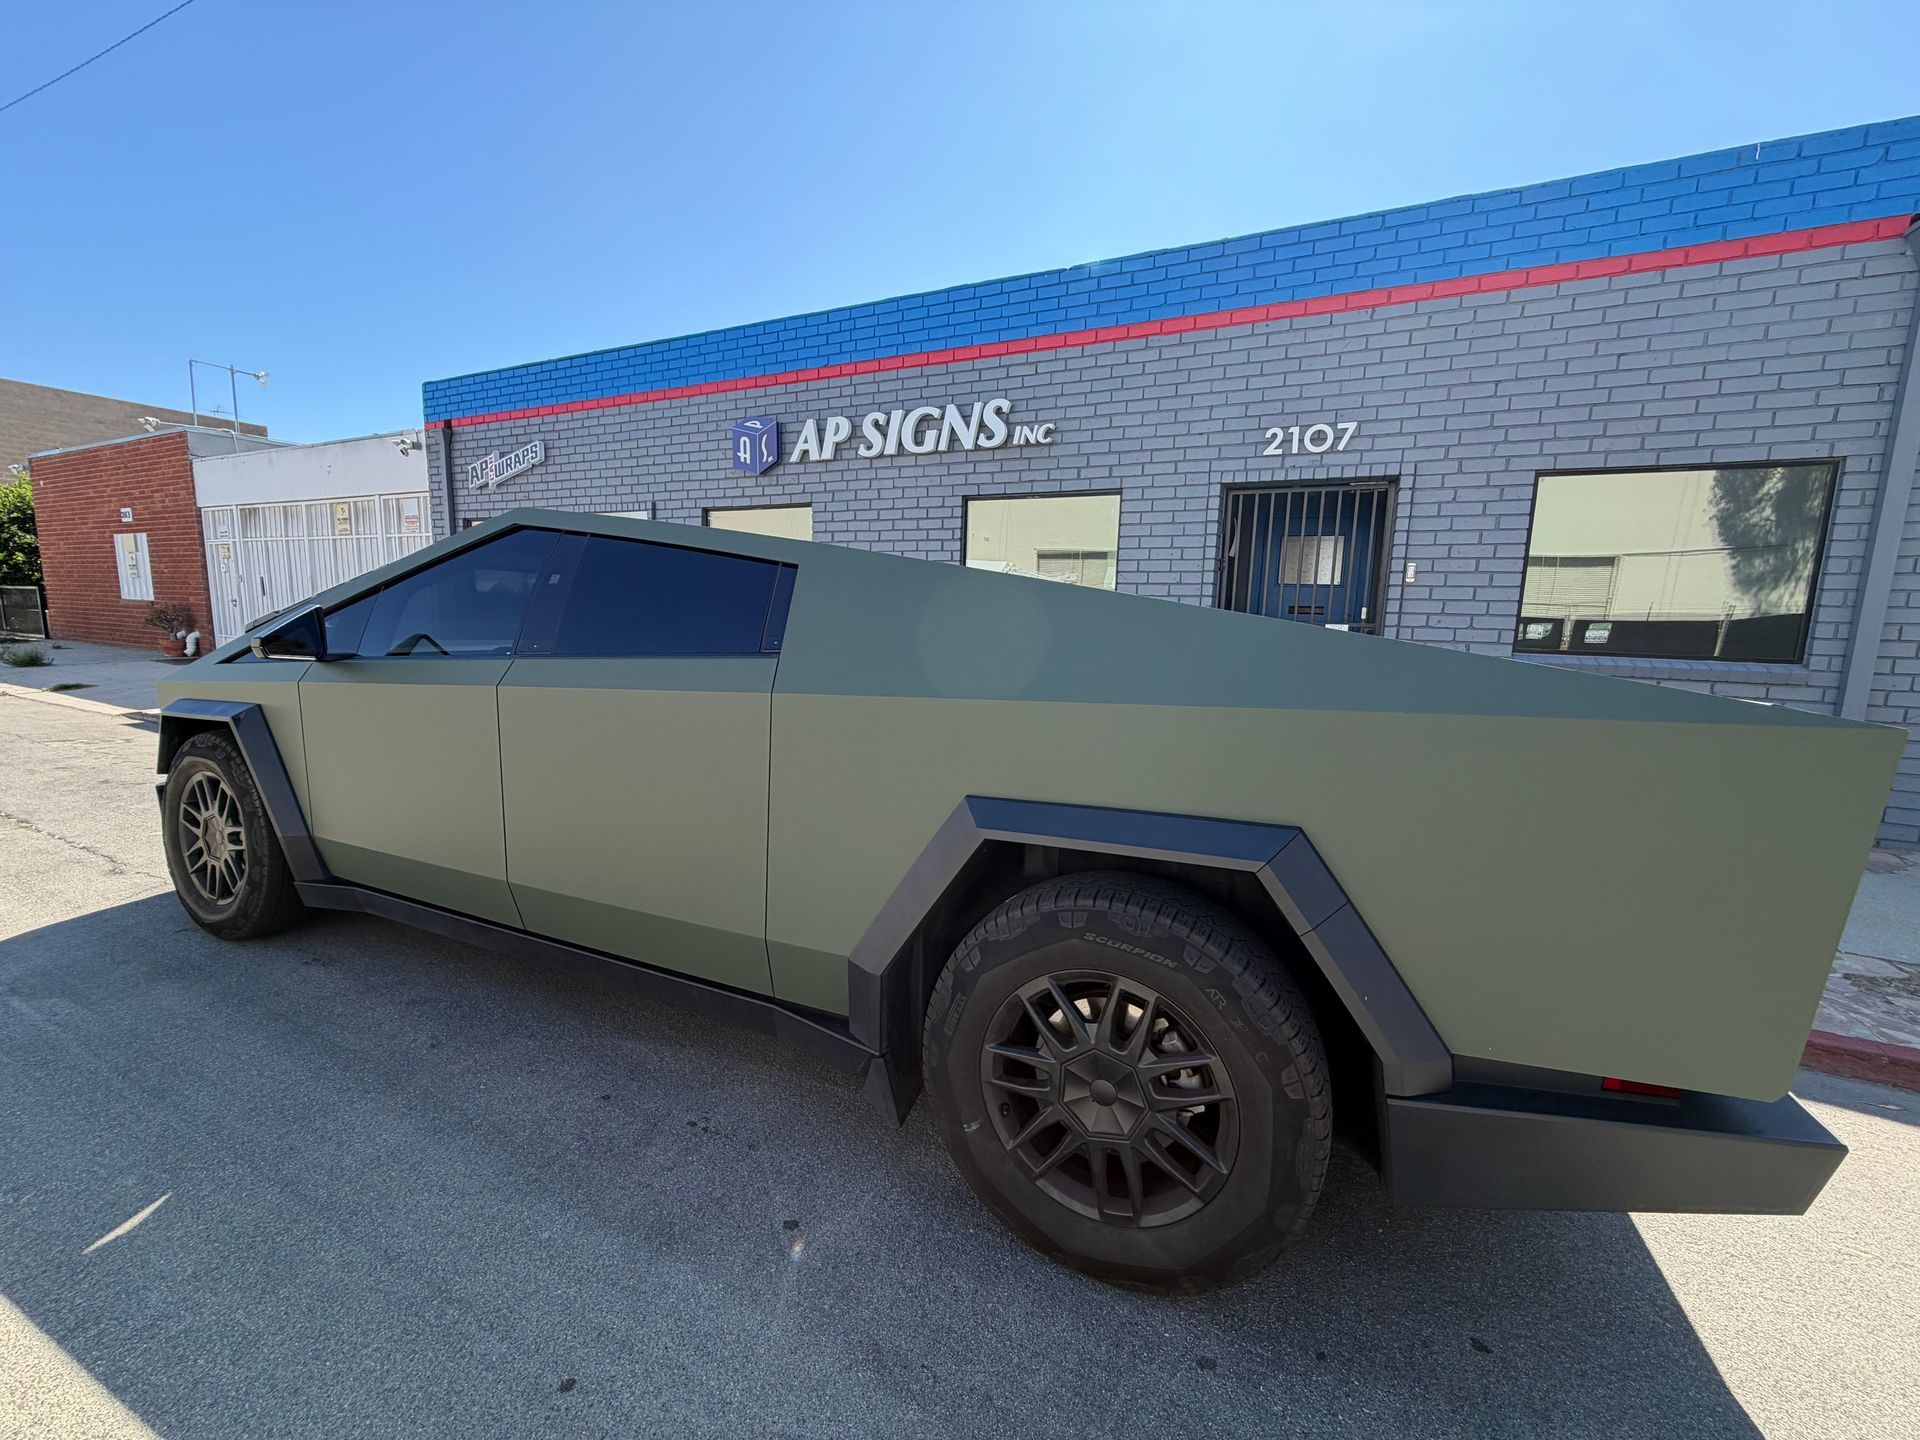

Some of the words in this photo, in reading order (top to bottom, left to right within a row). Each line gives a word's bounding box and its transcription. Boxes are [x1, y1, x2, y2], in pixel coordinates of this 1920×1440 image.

[789, 417, 852, 463] AP
[858, 398, 1012, 459] SIGNS
[1012, 423, 1056, 446] INC
[1262, 421, 1358, 456] 2107
[470, 458, 489, 487] AP
[494, 443, 538, 479] WRAPS
[1083, 932, 1178, 969] SCORPION
